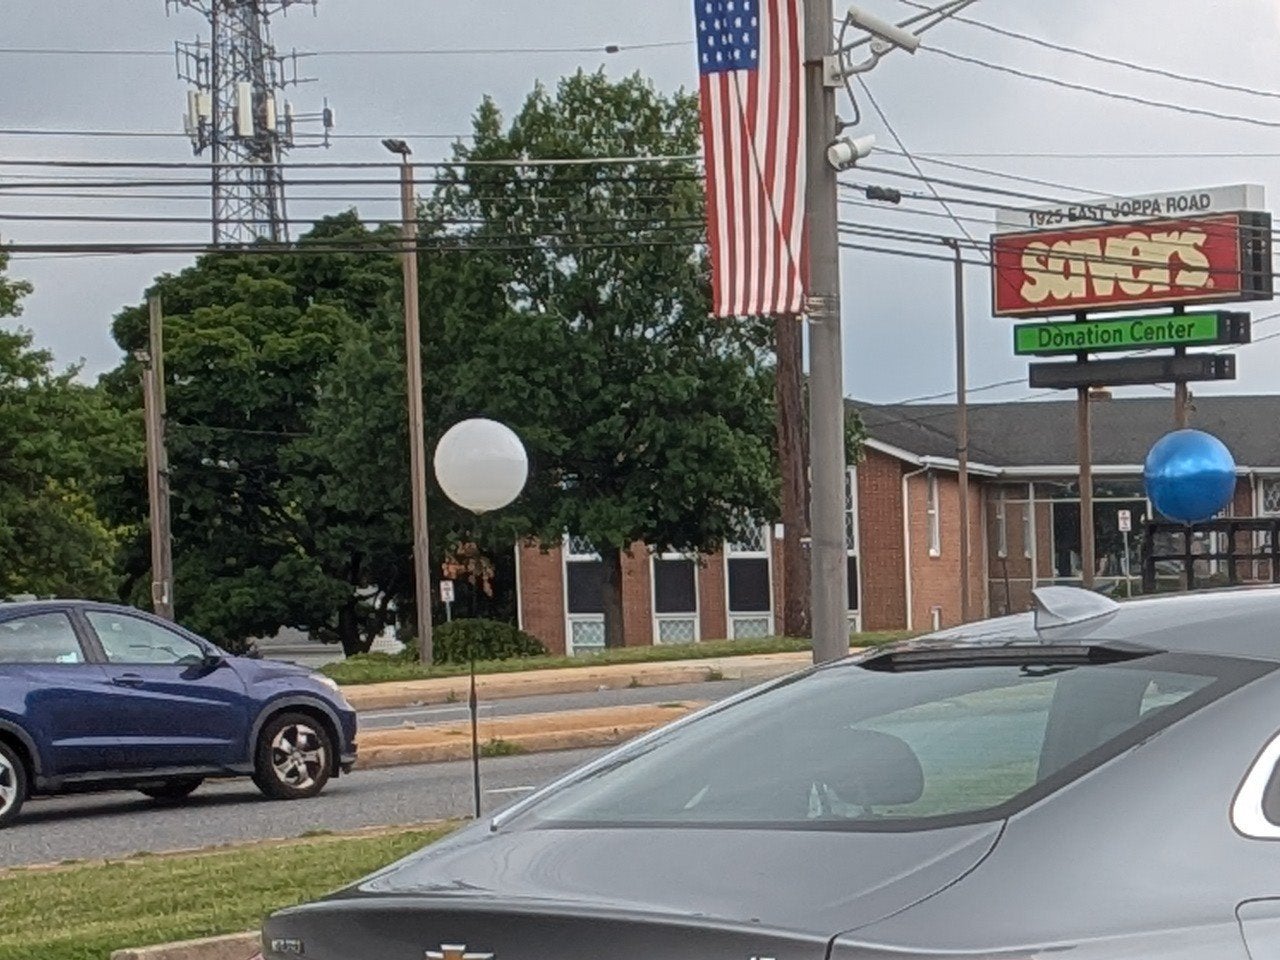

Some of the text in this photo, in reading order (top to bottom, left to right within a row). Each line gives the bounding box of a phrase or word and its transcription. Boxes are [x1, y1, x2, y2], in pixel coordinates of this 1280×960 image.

[1029, 193, 1211, 227] 1925 EAST JOPPA ROAD
[1038, 320, 1195, 347] Donation Center
